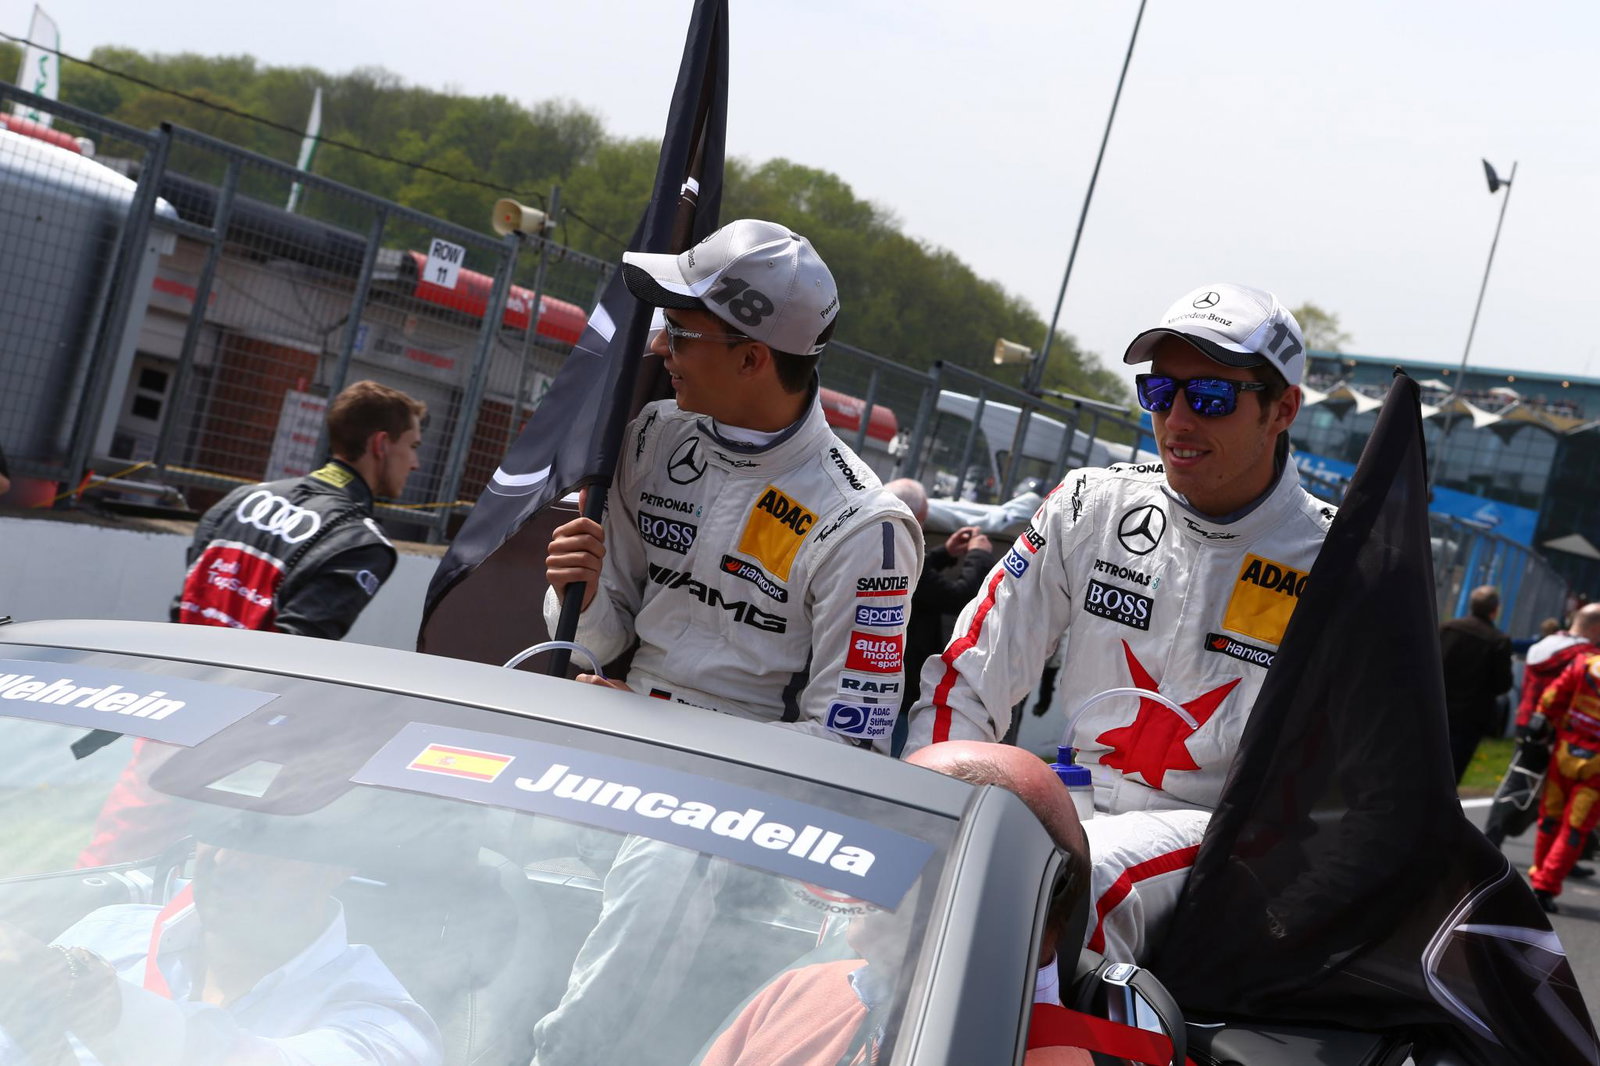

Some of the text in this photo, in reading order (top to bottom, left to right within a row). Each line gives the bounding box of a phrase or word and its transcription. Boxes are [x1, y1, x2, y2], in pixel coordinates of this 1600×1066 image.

[433, 241, 461, 264] ROW
[436, 267, 448, 284] 11
[710, 276, 774, 326] 18
[1267, 322, 1303, 366] 17
[829, 447, 866, 491] PETRONAS
[640, 491, 694, 514] PETRONAS
[756, 489, 813, 536] ADAC
[640, 514, 693, 546] BOSS
[210, 558, 240, 575] Audi
[1093, 558, 1152, 587] PETRONAS
[738, 565, 784, 601] Hankook
[856, 576, 909, 591] SANDTLER
[668, 571, 788, 634] AMG
[1088, 583, 1148, 620] BOSS
[1086, 603, 1145, 628] HUGO BOSS
[855, 639, 897, 653] auto
[863, 650, 900, 660] motor
[877, 658, 901, 669] sport
[841, 677, 900, 694] RAFI
[869, 717, 894, 728] Stiftung
[872, 707, 891, 716] ADAC
[866, 726, 885, 736] Sport
[514, 763, 877, 878] Juncadella
